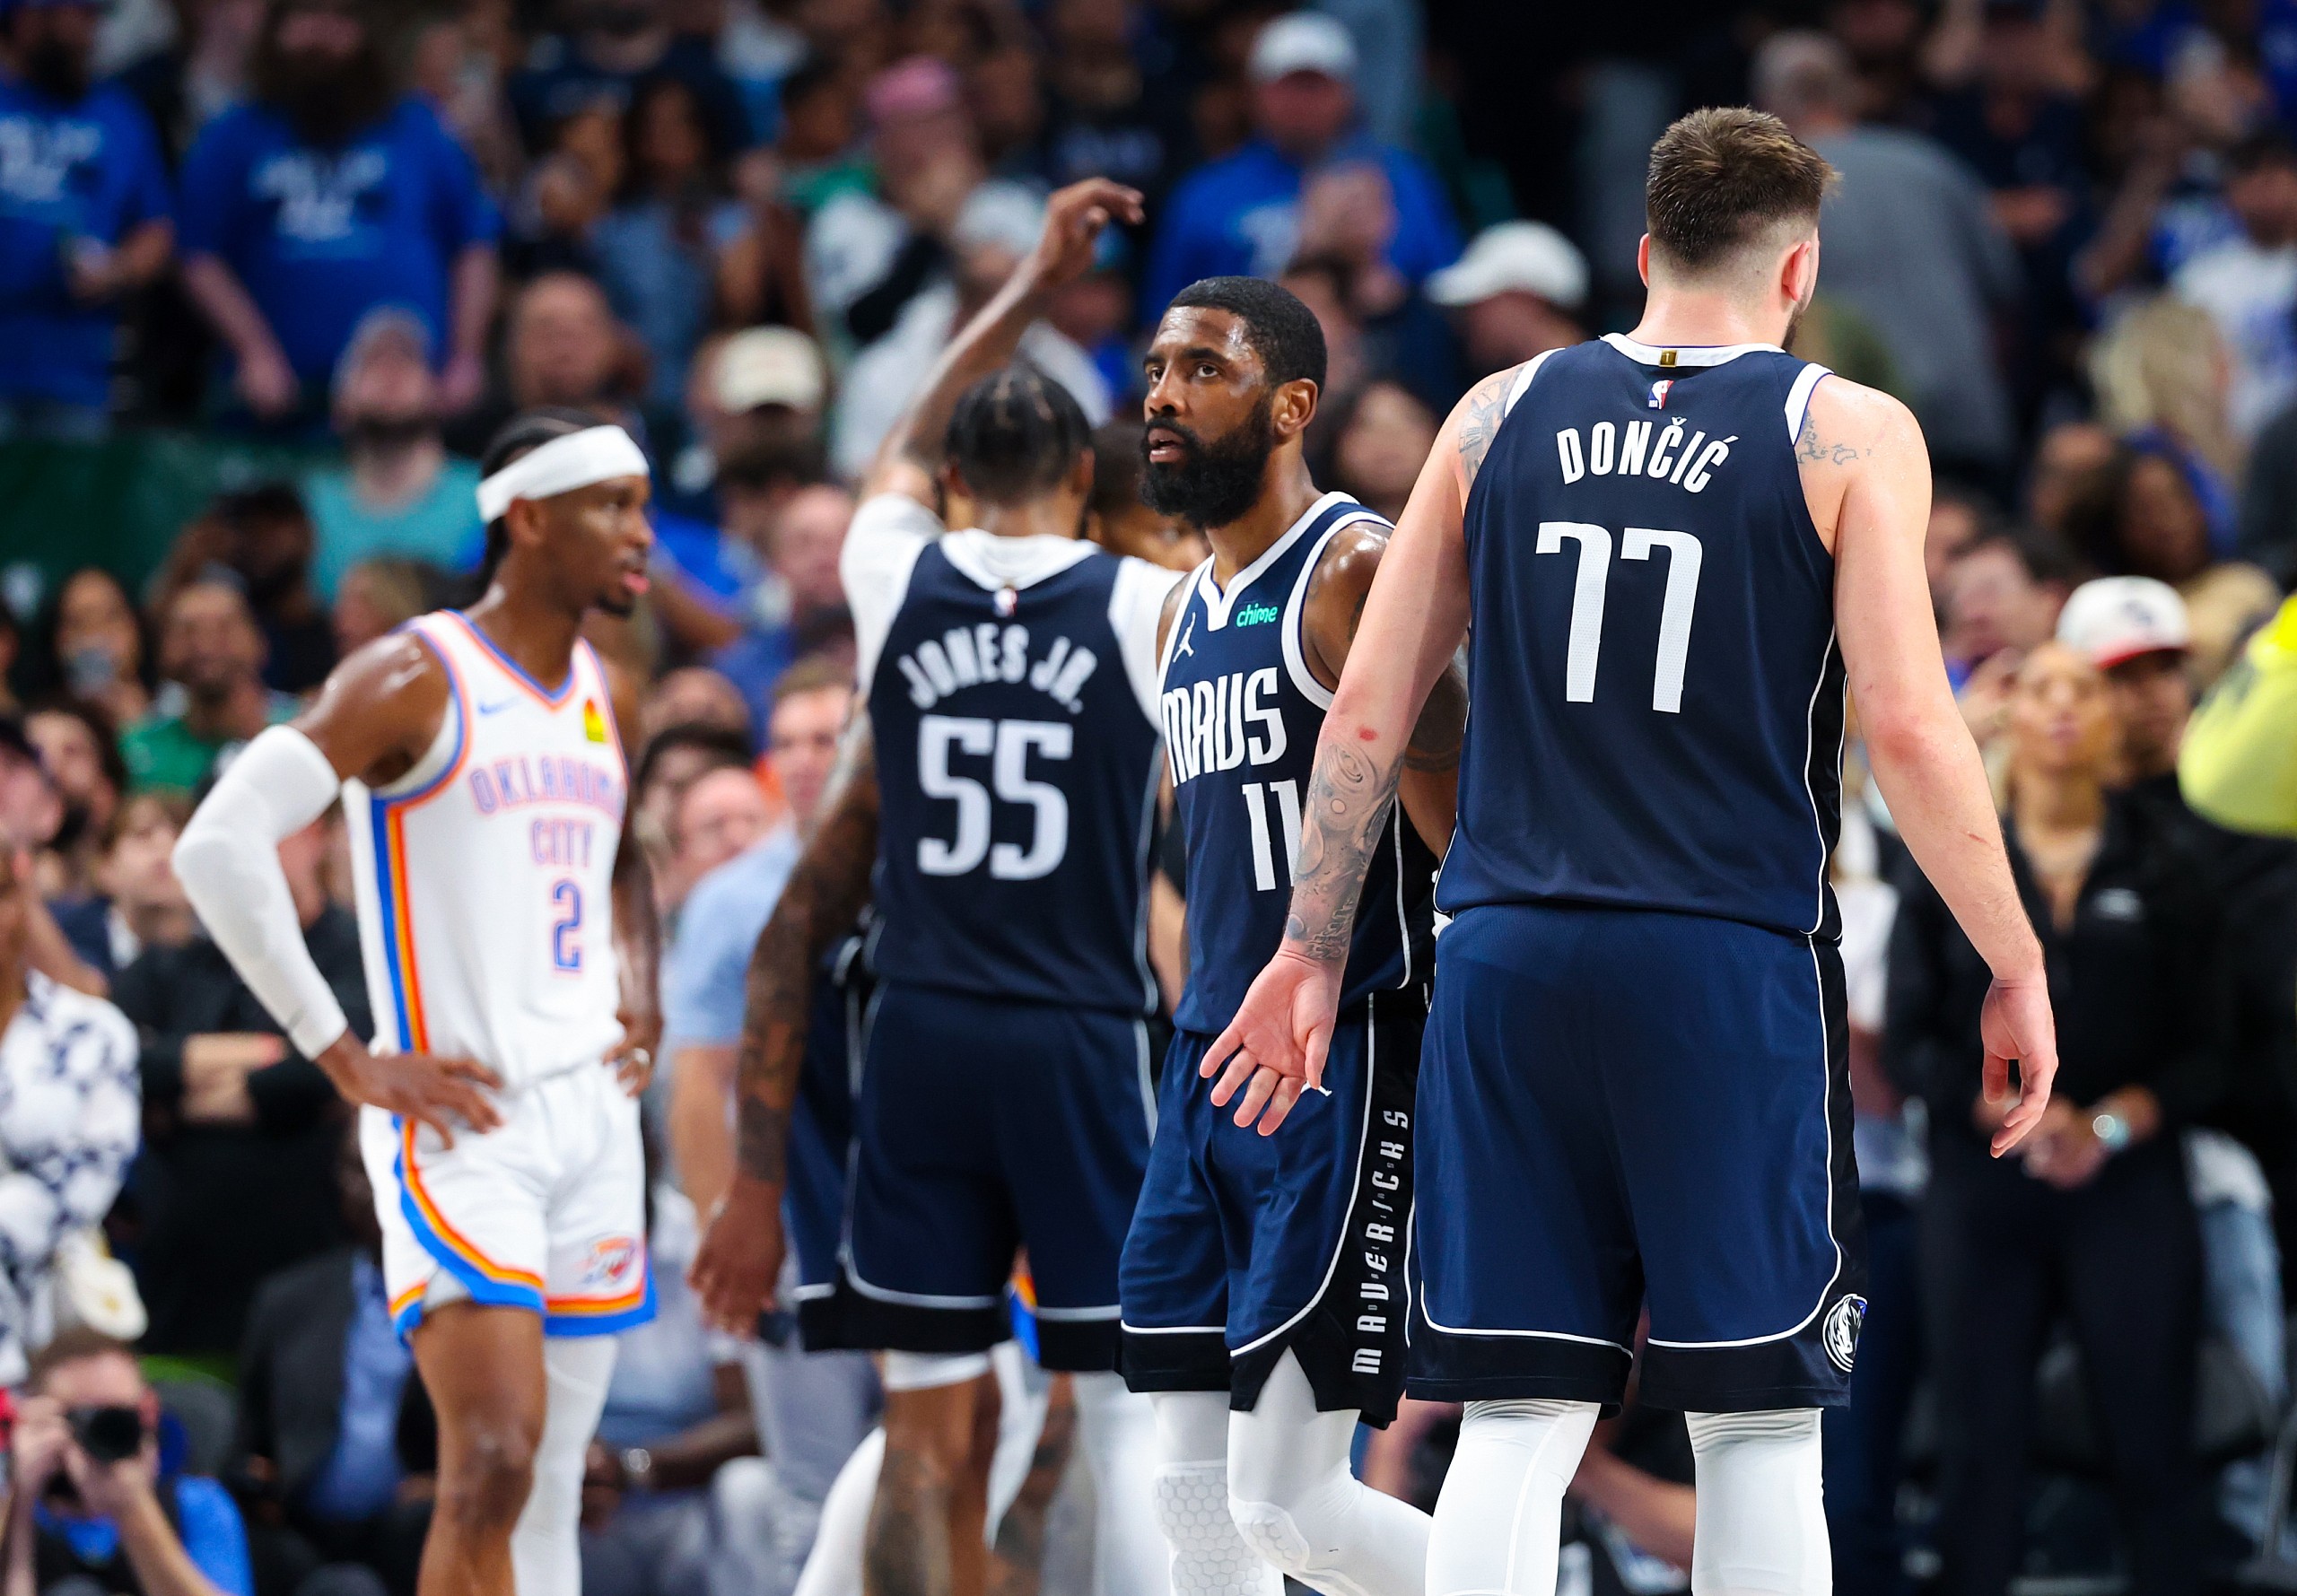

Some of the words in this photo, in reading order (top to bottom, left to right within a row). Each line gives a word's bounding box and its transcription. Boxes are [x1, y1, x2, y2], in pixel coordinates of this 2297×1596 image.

[1556, 416, 1739, 493] DONČIĆ
[898, 623, 1030, 710] JONES
[1236, 602, 1279, 628] chime
[1535, 521, 1703, 714] 77
[1162, 667, 1288, 789] MAVS
[530, 817, 595, 868] CITY
[917, 714, 1074, 881] 55
[1242, 779, 1304, 892] 11
[553, 877, 582, 974] 2
[1351, 1110, 1409, 1374] MAVERICKS
